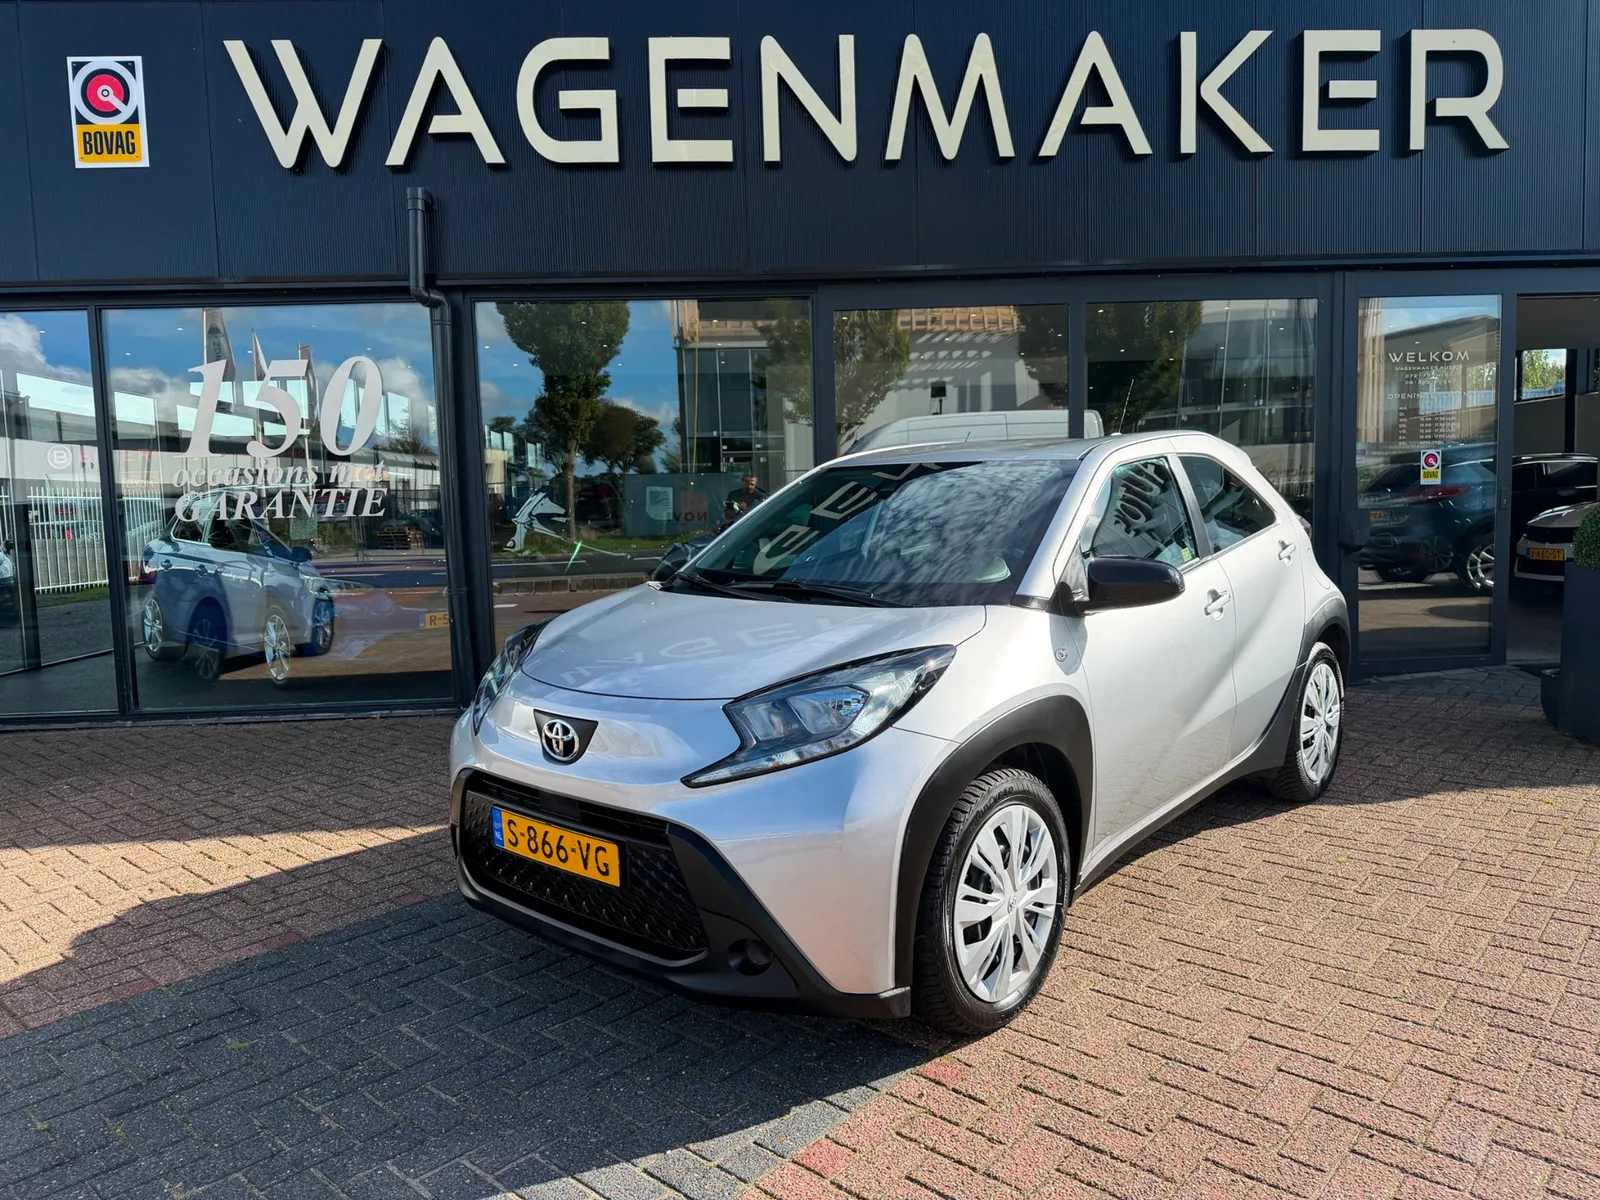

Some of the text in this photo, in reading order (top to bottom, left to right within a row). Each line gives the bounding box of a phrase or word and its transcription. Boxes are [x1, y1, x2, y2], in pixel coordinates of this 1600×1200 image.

[224, 29, 1510, 170] WAGENMAKER
[82, 131, 136, 155] BOVAG
[1388, 351, 1470, 362] WELKOM
[174, 356, 383, 458] 150
[172, 459, 386, 488] occasions met
[174, 487, 388, 522] GARANTIE
[507, 819, 610, 877] S-866-VG
